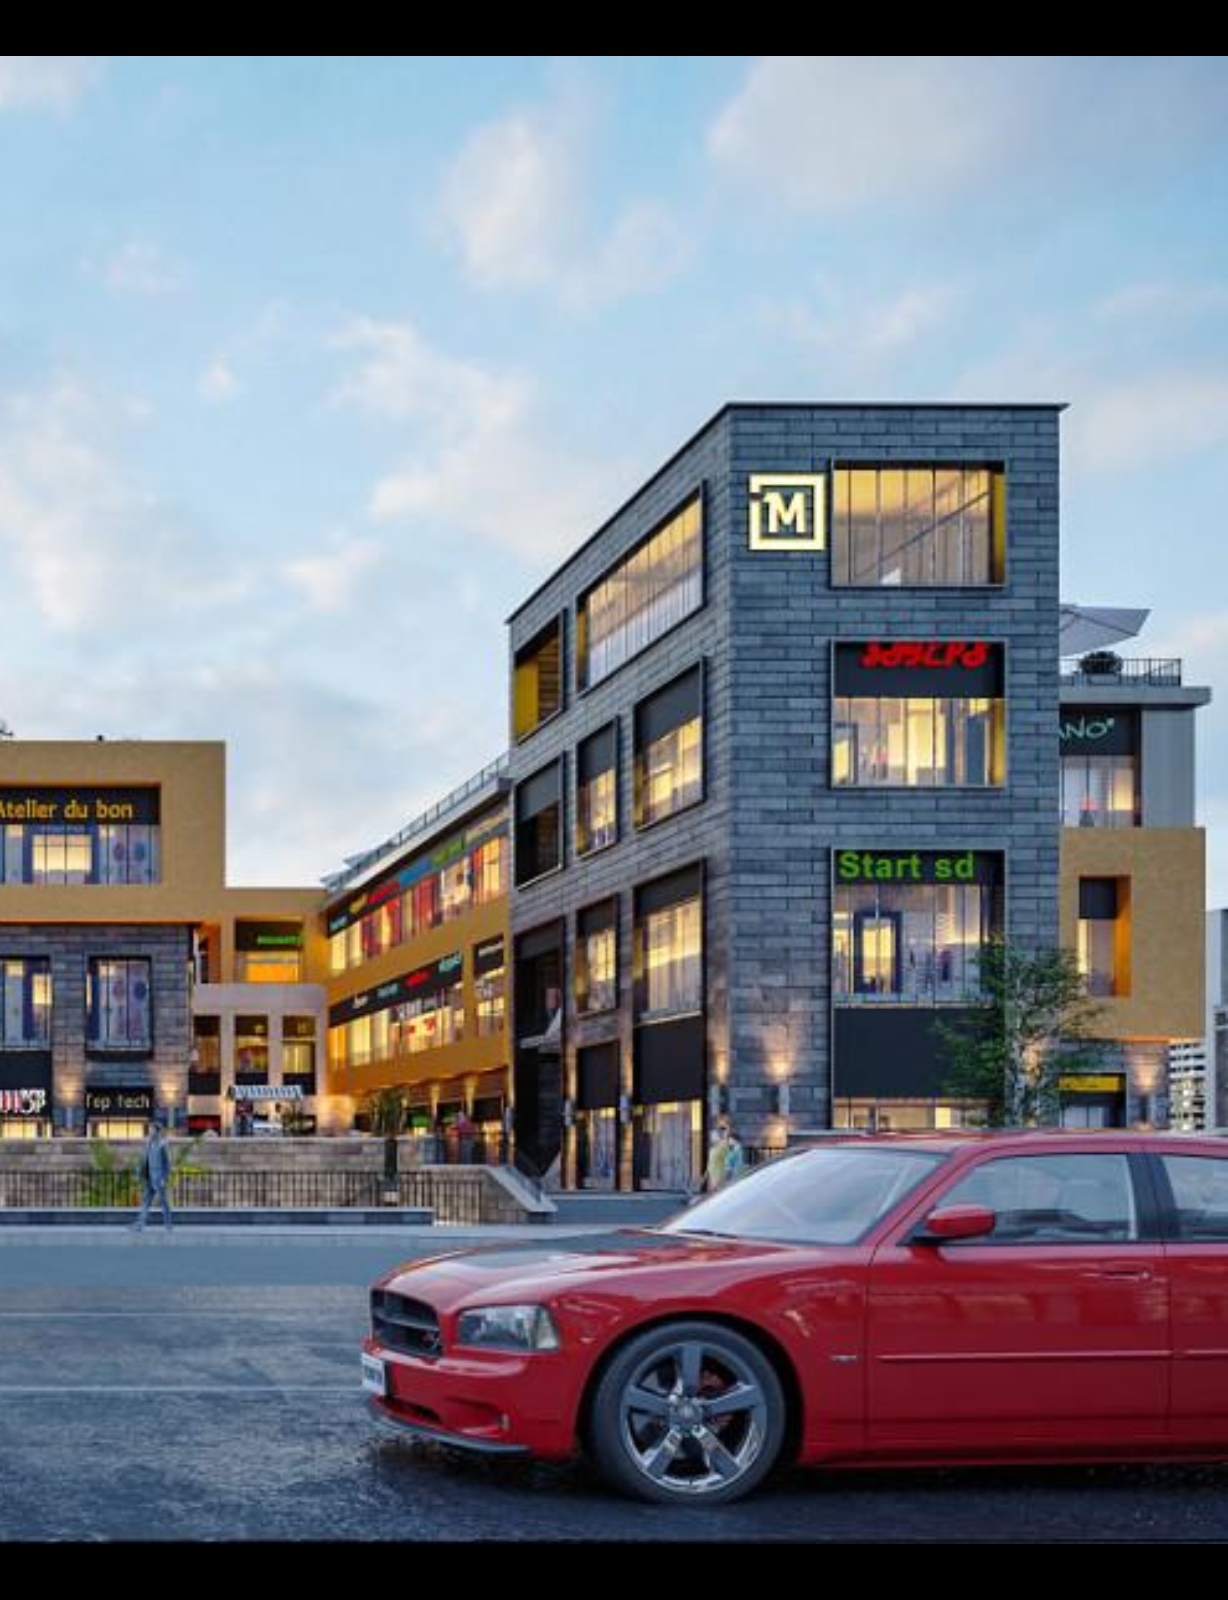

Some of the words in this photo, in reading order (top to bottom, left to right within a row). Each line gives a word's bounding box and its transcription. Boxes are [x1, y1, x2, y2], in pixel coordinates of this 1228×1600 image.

[64, 799, 88, 819] du
[96, 799, 133, 819] bon
[839, 851, 922, 879] Start
[934, 850, 974, 879] sd
